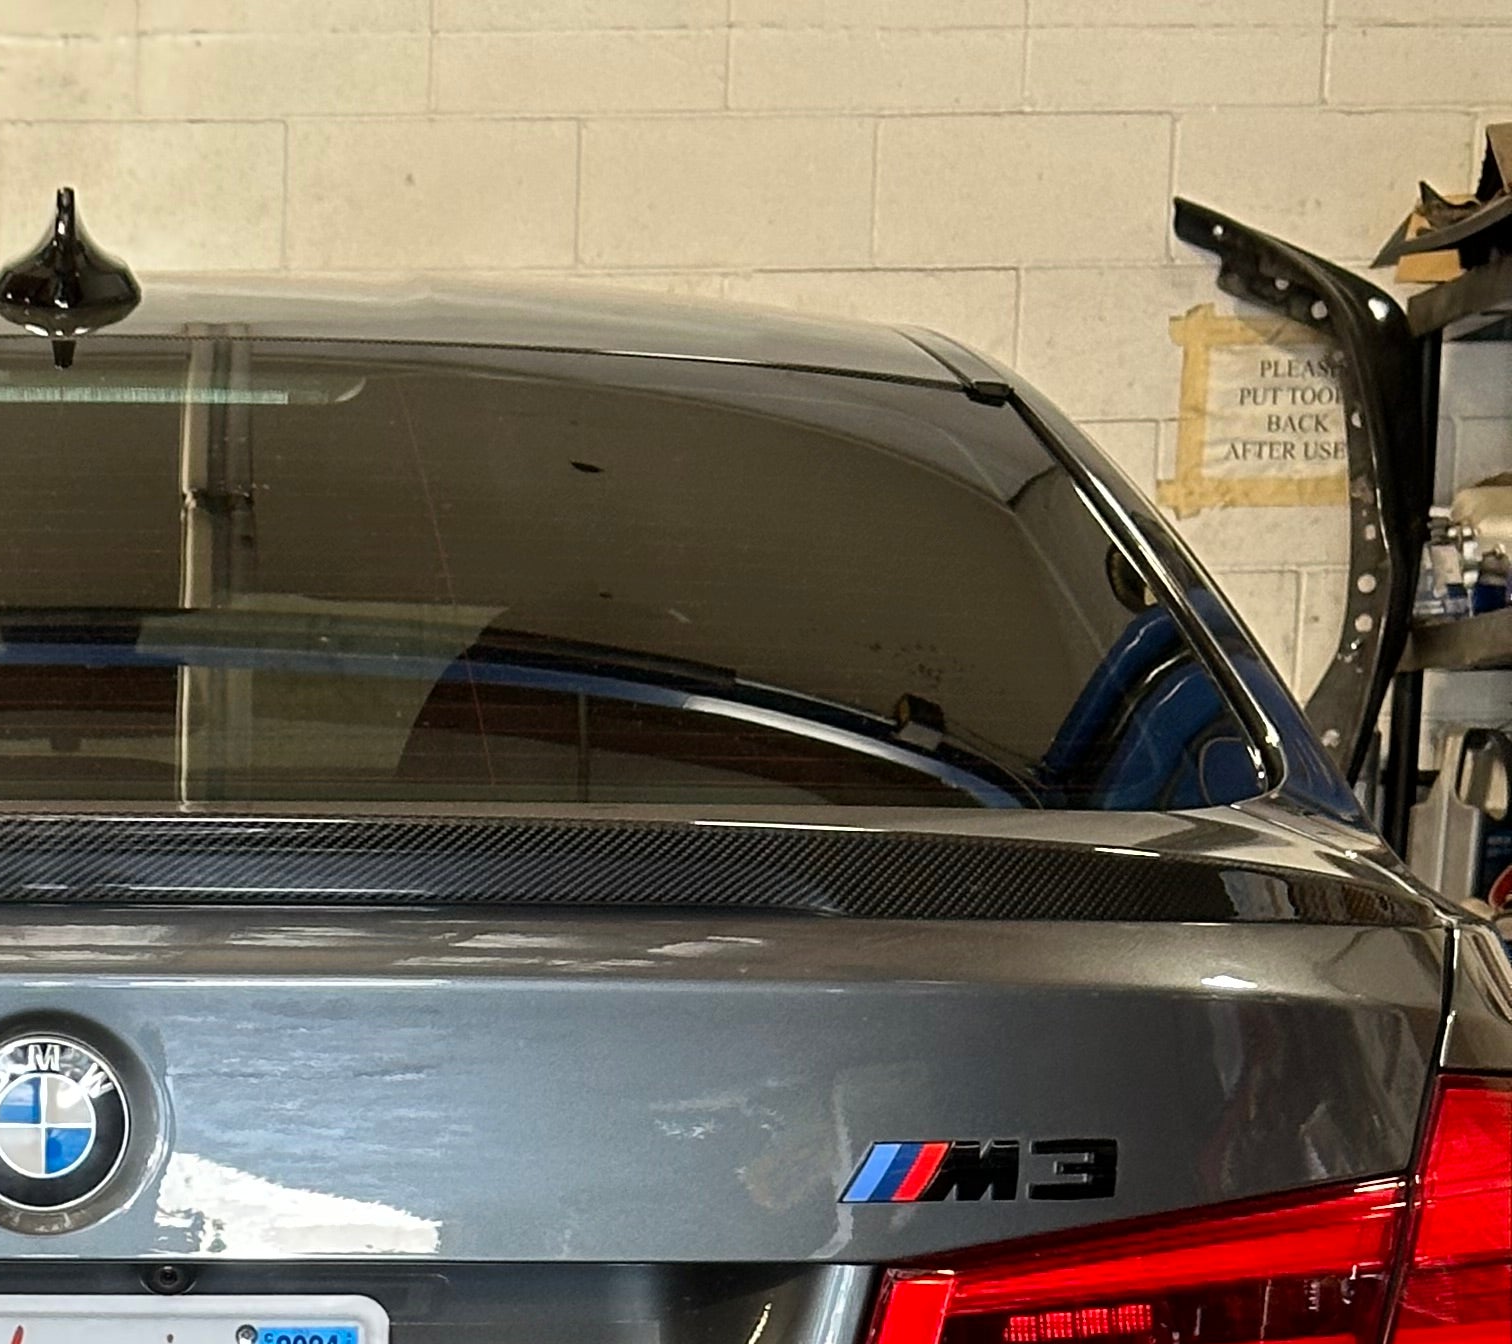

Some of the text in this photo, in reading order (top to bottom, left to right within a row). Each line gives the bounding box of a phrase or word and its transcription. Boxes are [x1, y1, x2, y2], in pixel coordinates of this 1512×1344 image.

[1240, 387, 1283, 405] PUT
[1267, 415, 1328, 433] BACK
[1224, 441, 1345, 460] AFTER USE
[915, 1139, 1118, 1201] M3
